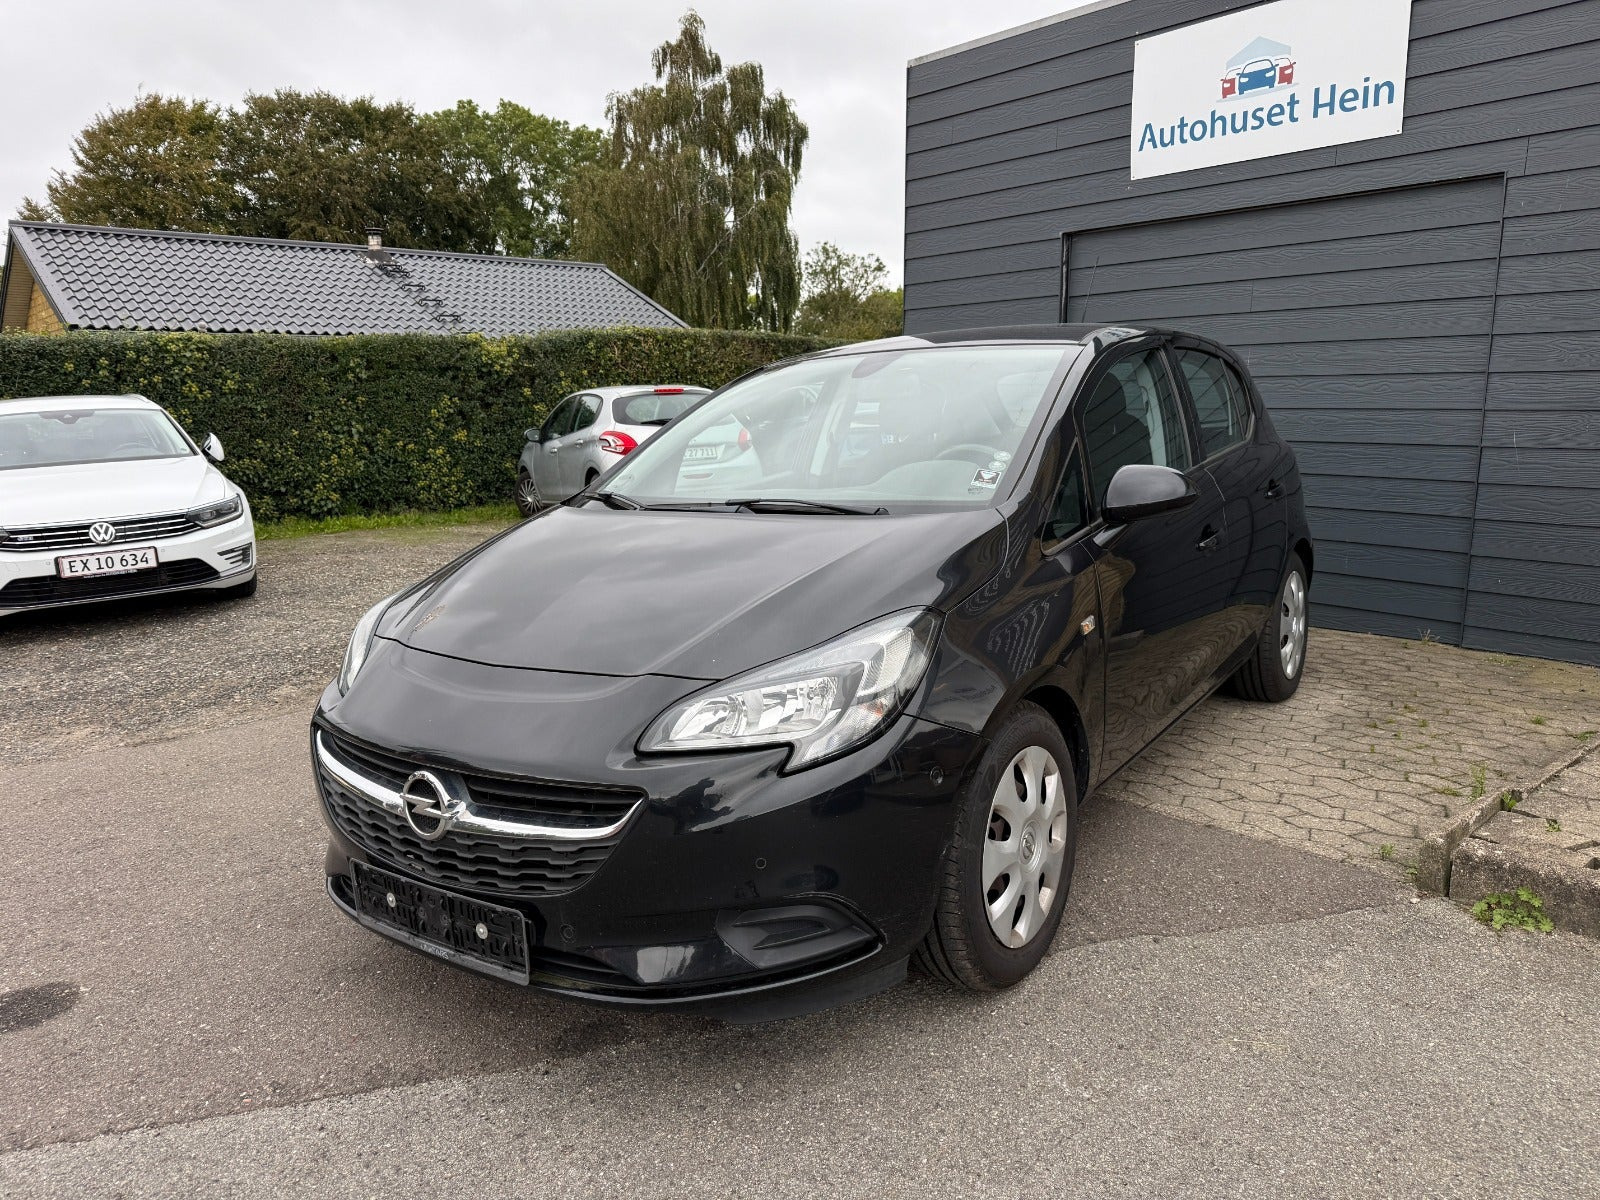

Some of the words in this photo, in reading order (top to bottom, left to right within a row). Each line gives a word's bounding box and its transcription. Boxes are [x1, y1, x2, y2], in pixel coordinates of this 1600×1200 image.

[1138, 93, 1299, 152] Autohuset
[1312, 76, 1395, 119] Hein
[69, 560, 91, 573] EX
[95, 556, 115, 570] 10
[119, 553, 149, 567] 634
